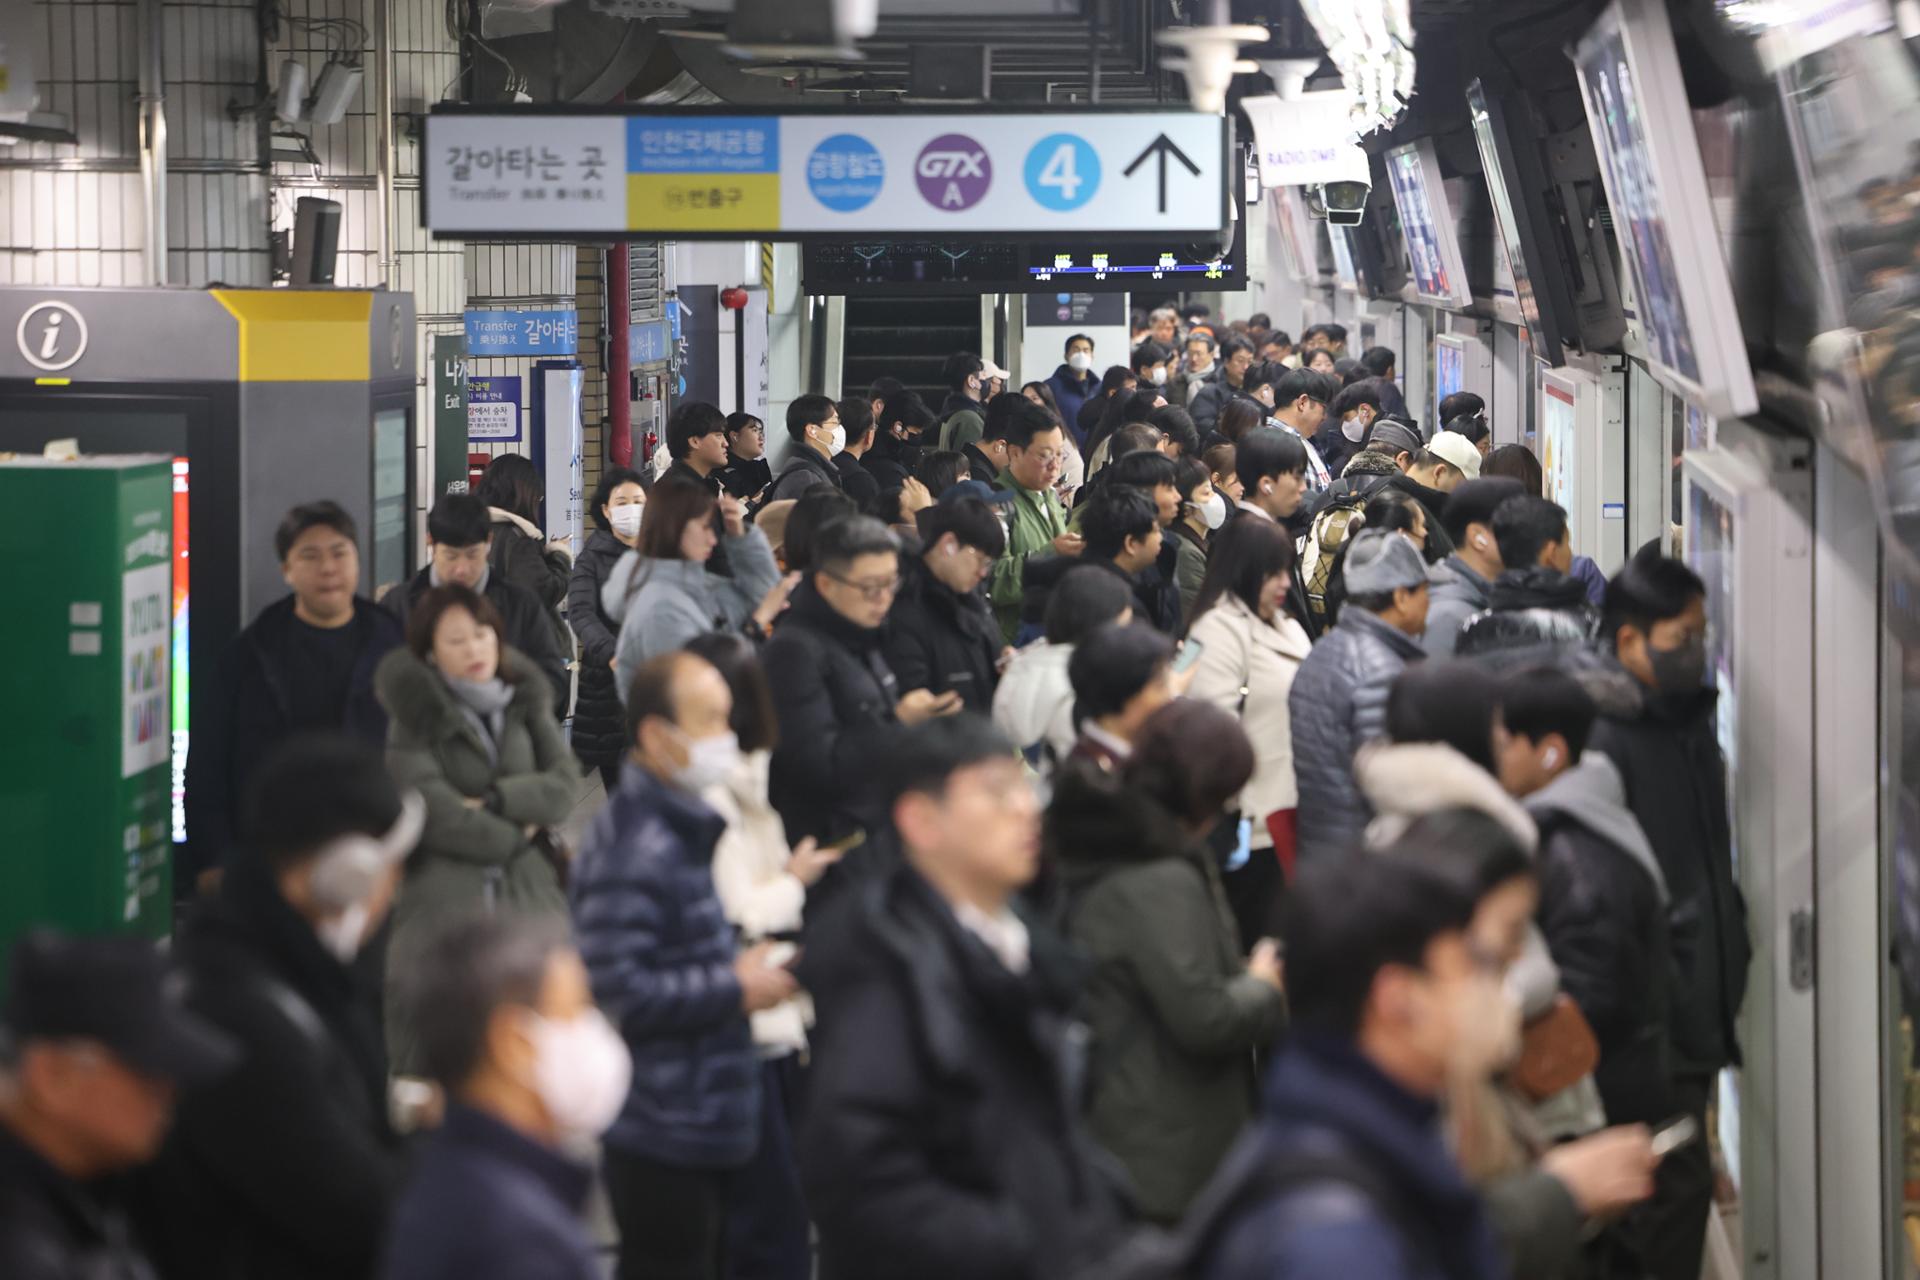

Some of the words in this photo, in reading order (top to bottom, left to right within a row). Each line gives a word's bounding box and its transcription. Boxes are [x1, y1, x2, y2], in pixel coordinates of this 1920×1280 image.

[640, 129, 765, 154] 인천국제공항
[446, 145, 565, 181] 갈아타는
[577, 146, 607, 181] 곳
[918, 151, 986, 178] GTX
[1038, 144, 1082, 199] 4
[942, 182, 964, 207] A
[473, 320, 518, 332] Transfer
[445, 394, 460, 409] Exit
